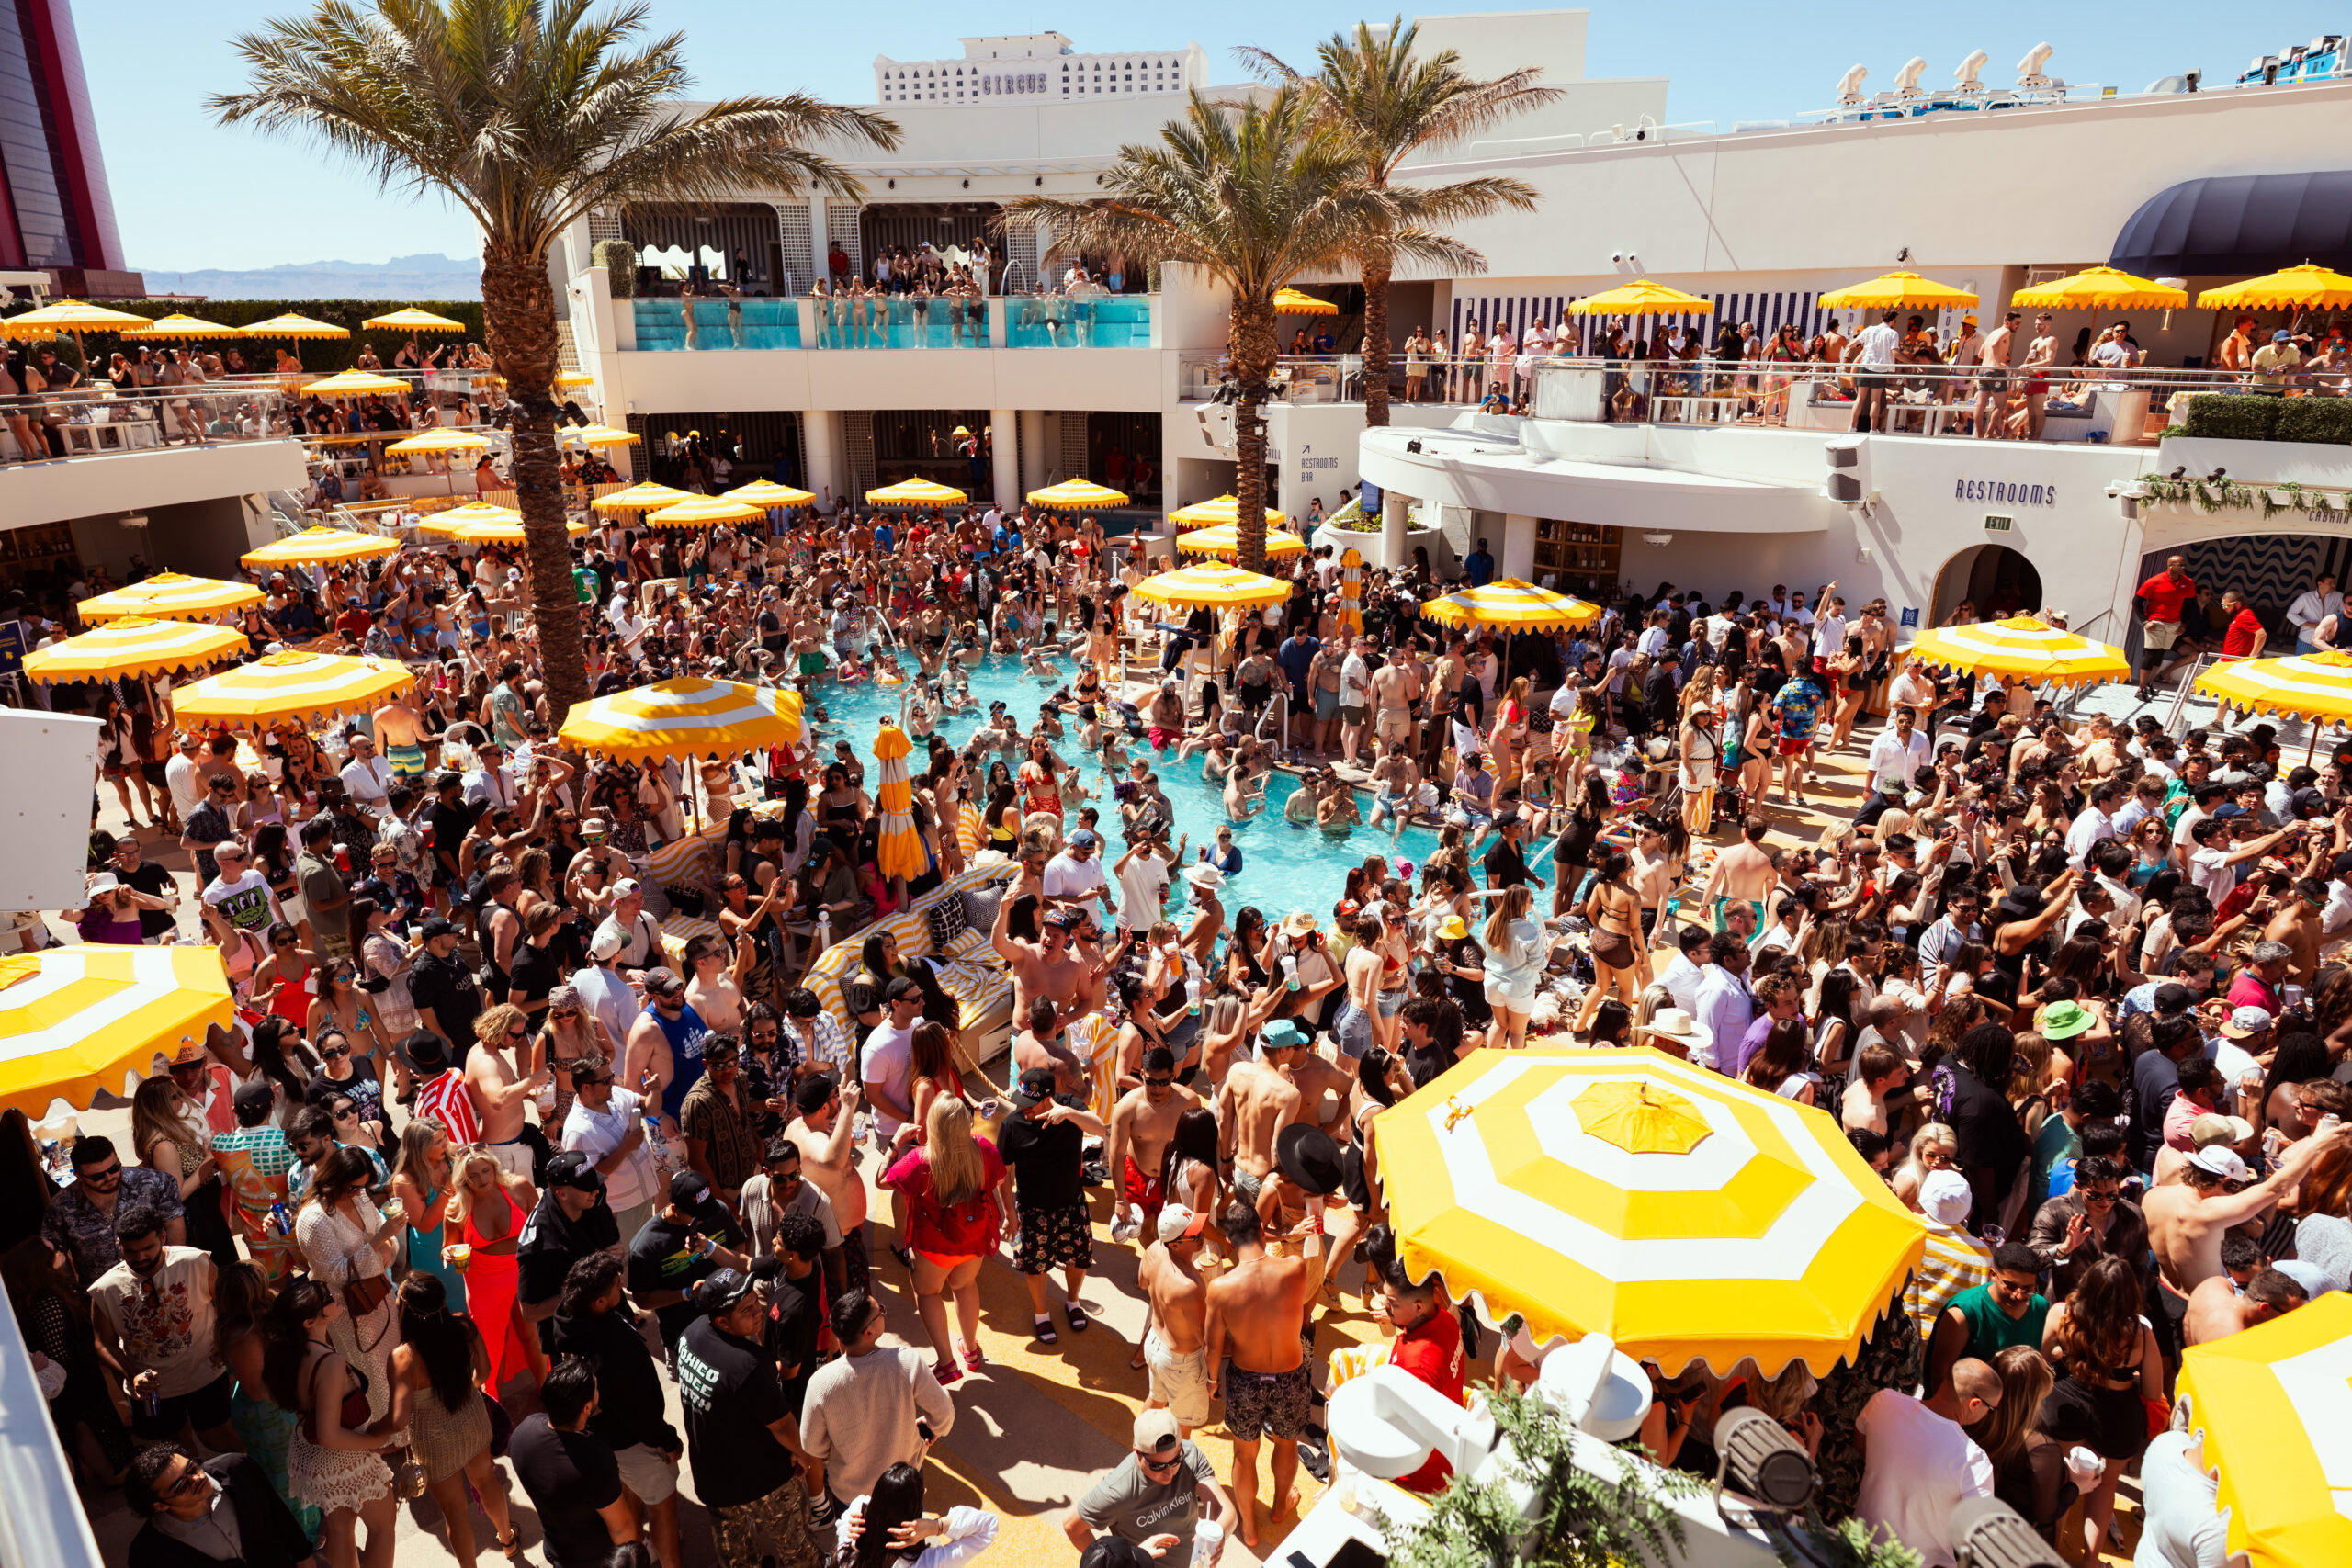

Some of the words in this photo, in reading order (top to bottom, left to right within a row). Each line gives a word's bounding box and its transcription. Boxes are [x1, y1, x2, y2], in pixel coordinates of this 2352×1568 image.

[982, 73, 1046, 96] CIRCUS
[1268, 448, 1281, 459] RILL
[1301, 457, 1339, 468] RESTROOMS
[1301, 471, 1314, 482] BAR
[1955, 479, 2055, 504] RESTROOMS
[1989, 517, 2009, 530] EXIT
[2309, 510, 2350, 524] CABANA
[1136, 1506, 1170, 1528] Calvin
[1169, 1491, 1193, 1511] Klein
